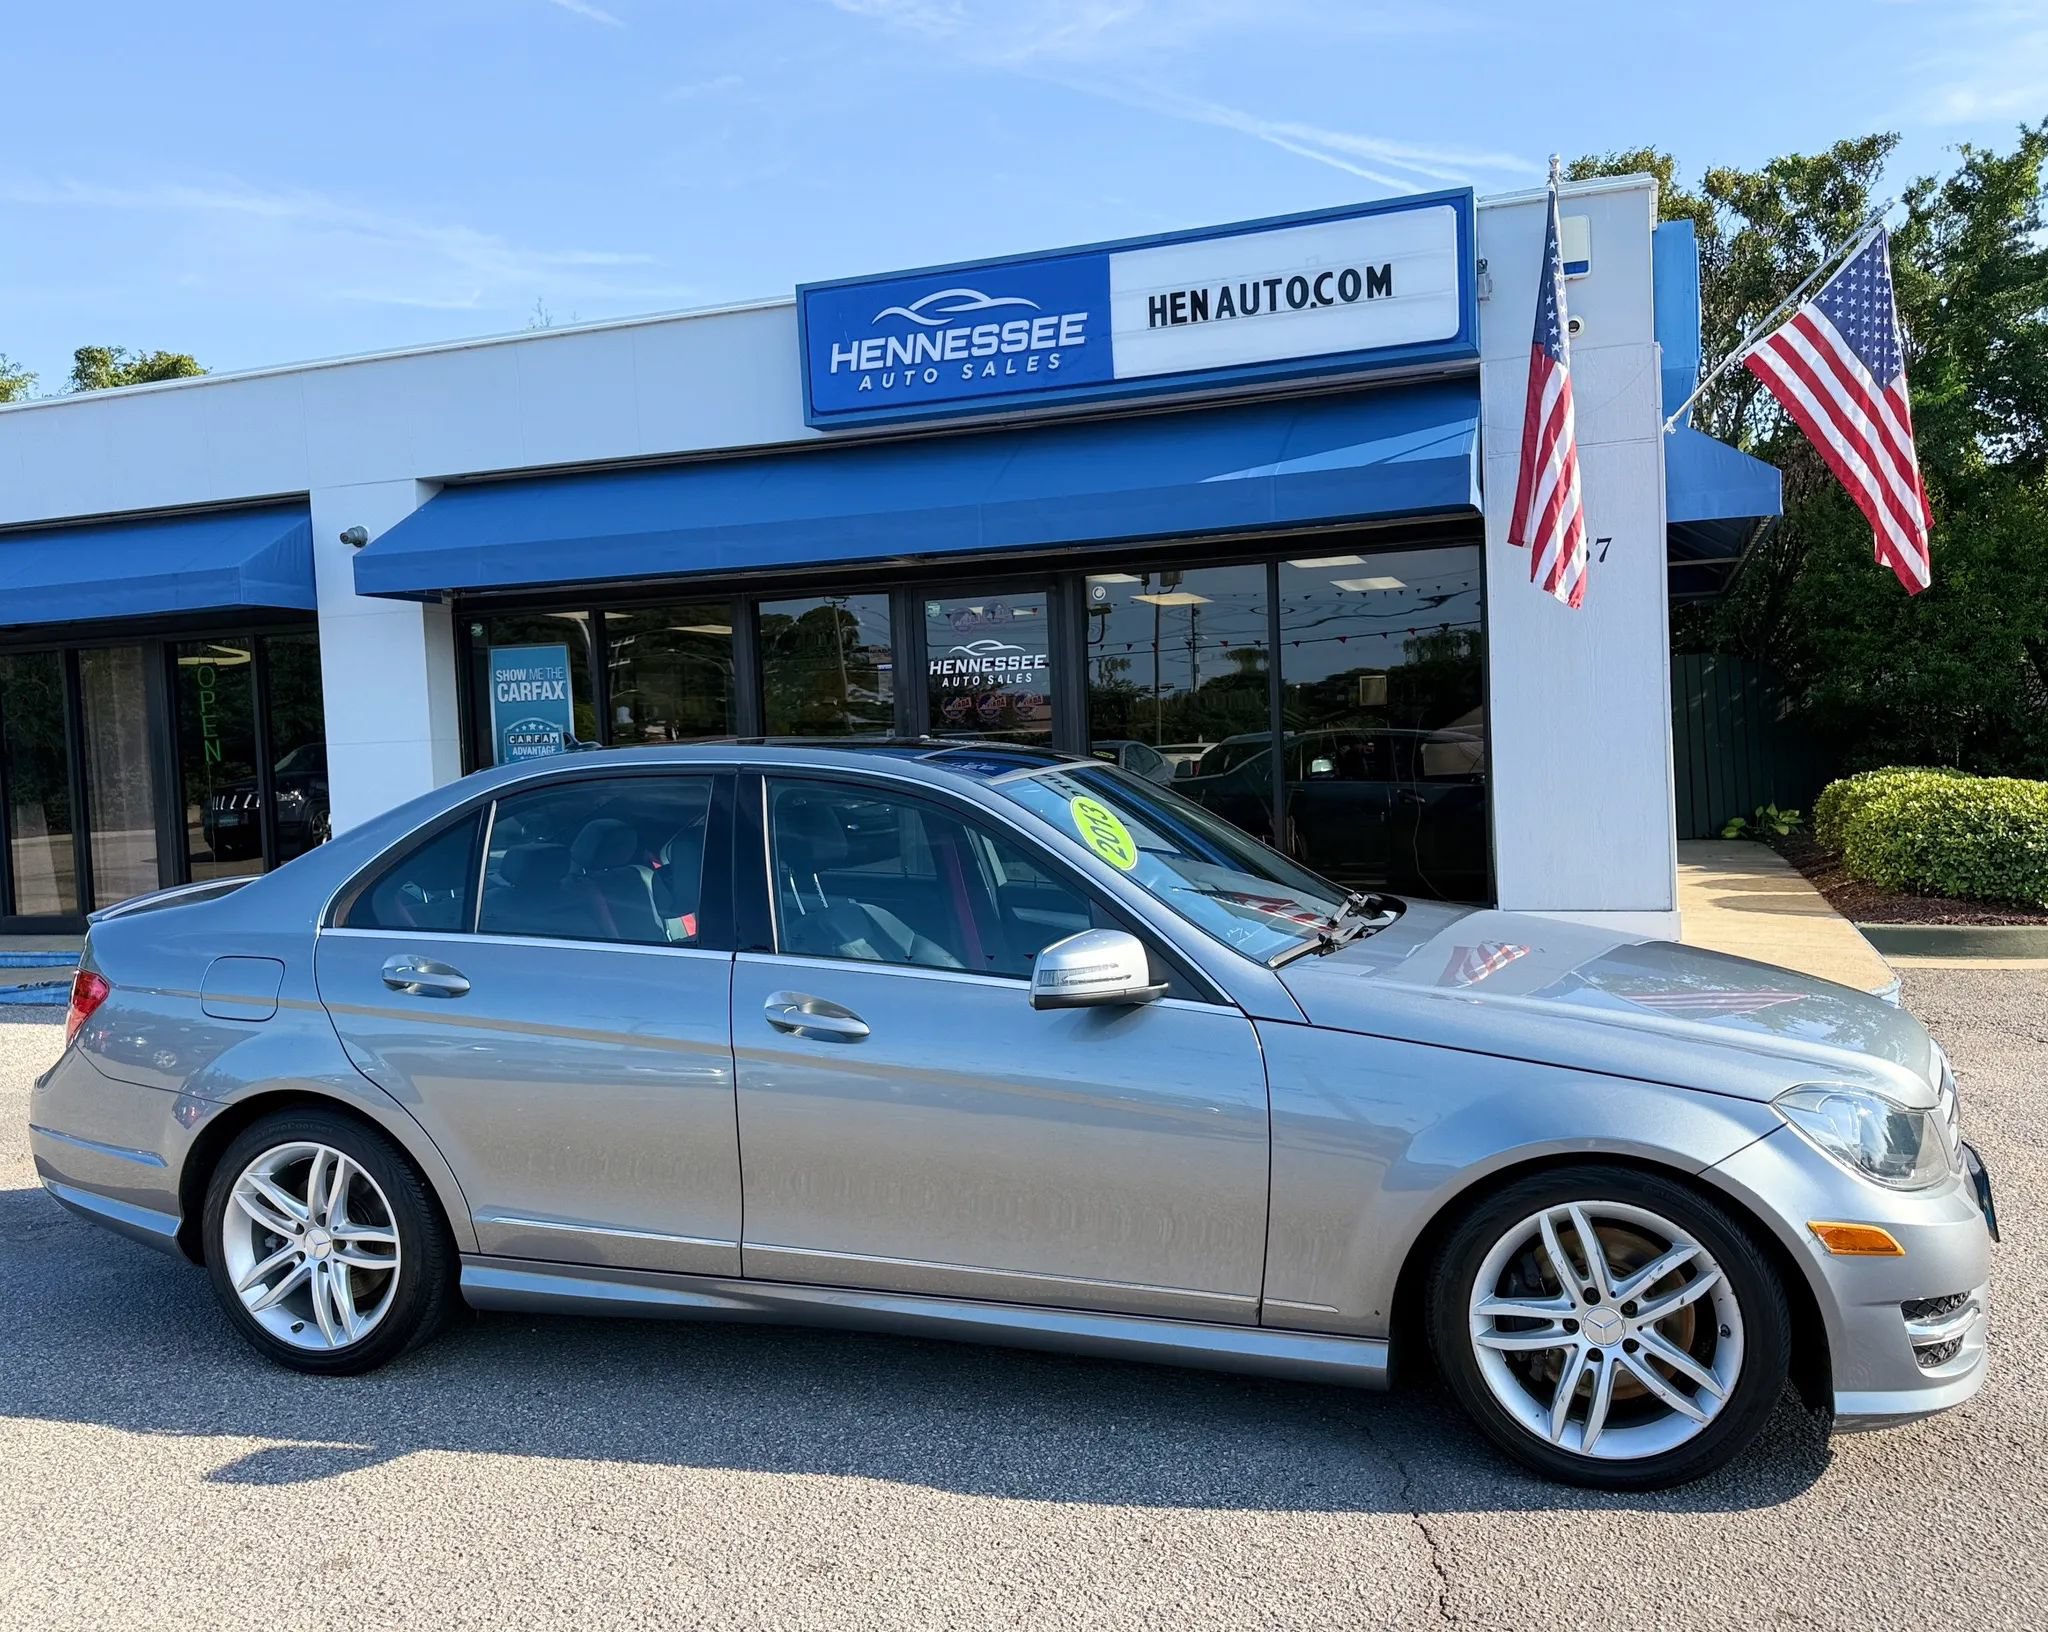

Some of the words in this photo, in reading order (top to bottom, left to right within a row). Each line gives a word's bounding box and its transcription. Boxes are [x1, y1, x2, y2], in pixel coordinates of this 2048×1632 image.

[830, 312, 1089, 374] HENNESSEE
[858, 366, 938, 392] AUTO
[961, 351, 1062, 381] SALES
[496, 668, 526, 682] SHOW
[529, 668, 544, 680] ME
[546, 667, 564, 679] THE
[929, 654, 1046, 675] HENNESSEE
[942, 675, 981, 688] AUTO
[987, 672, 1032, 685] SALES
[498, 681, 564, 702] CARFAX
[197, 665, 221, 762] OPEN
[509, 734, 558, 744] CARFAX
[512, 745, 557, 756] ADVANTAGE
[1078, 802, 1129, 861] 2013
